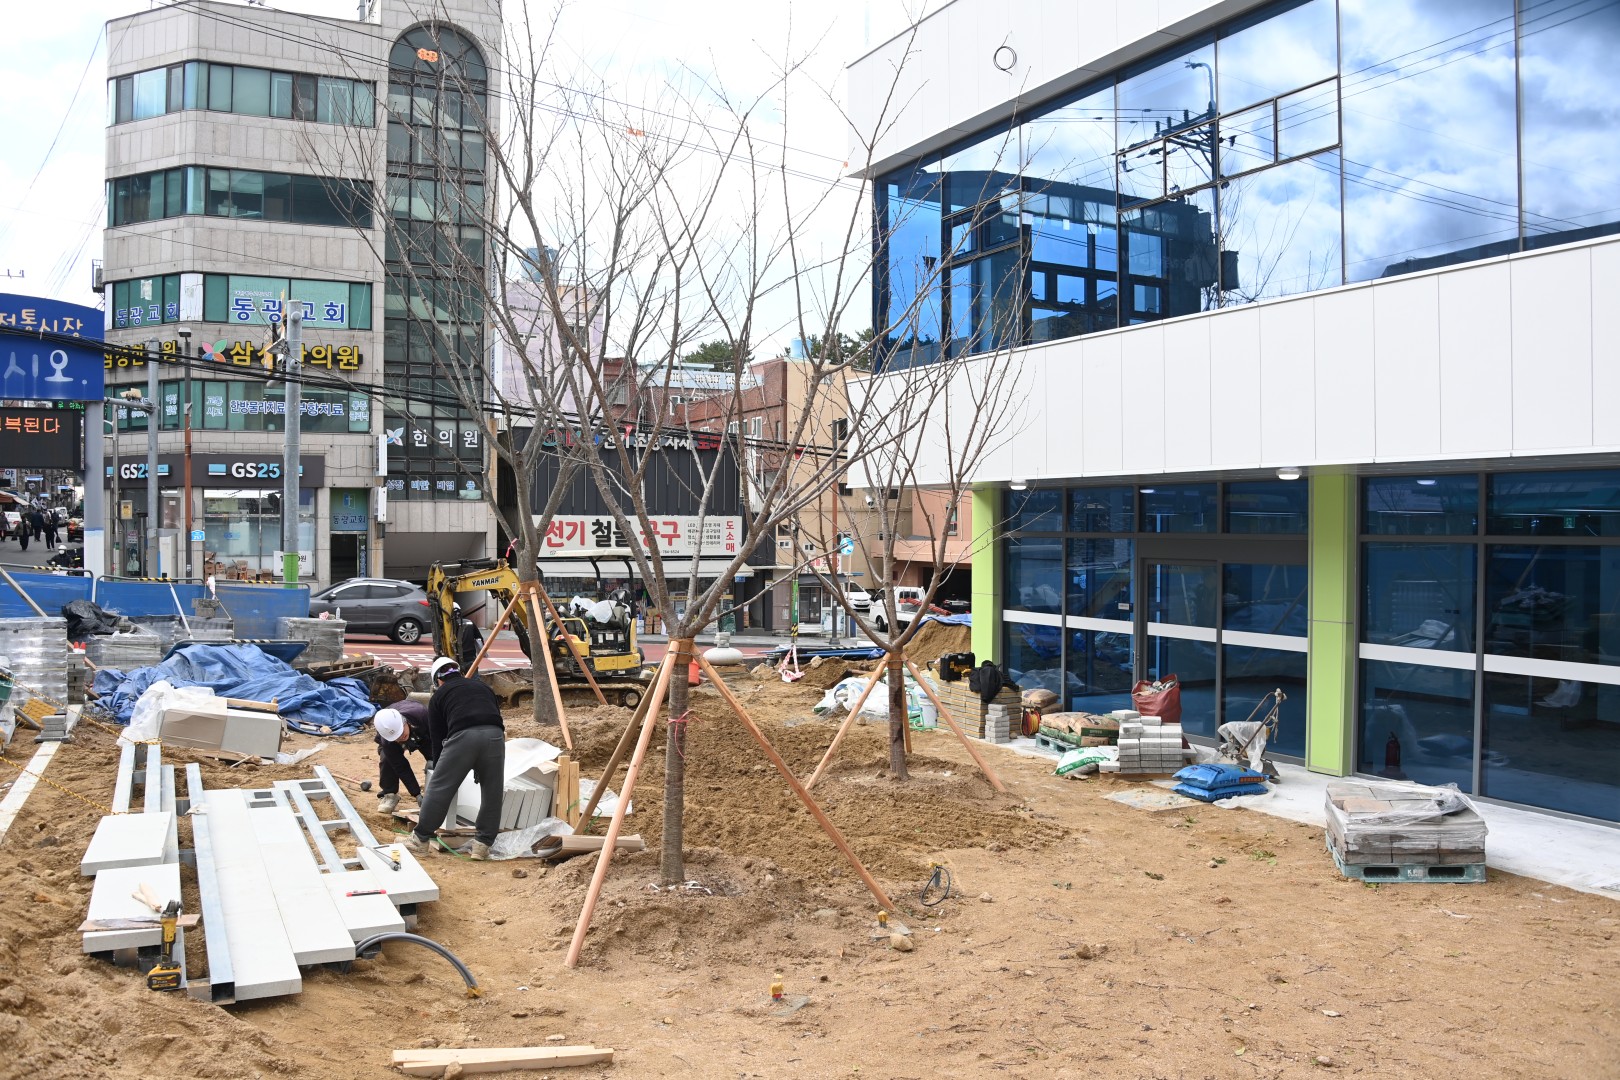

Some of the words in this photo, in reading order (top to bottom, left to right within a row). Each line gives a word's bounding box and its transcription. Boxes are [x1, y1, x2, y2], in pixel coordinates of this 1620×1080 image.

[116, 302, 179, 327] 동광교회
[229, 341, 360, 370] 삼의원
[230, 400, 285, 415] 한방물리치료
[412, 428, 479, 448] 한의원
[120, 463, 148, 479] GS2
[231, 462, 281, 479] GS25
[333, 515, 366, 525] 동광교회
[545, 520, 585, 548] 전기
[471, 577, 499, 587] YANMAR
